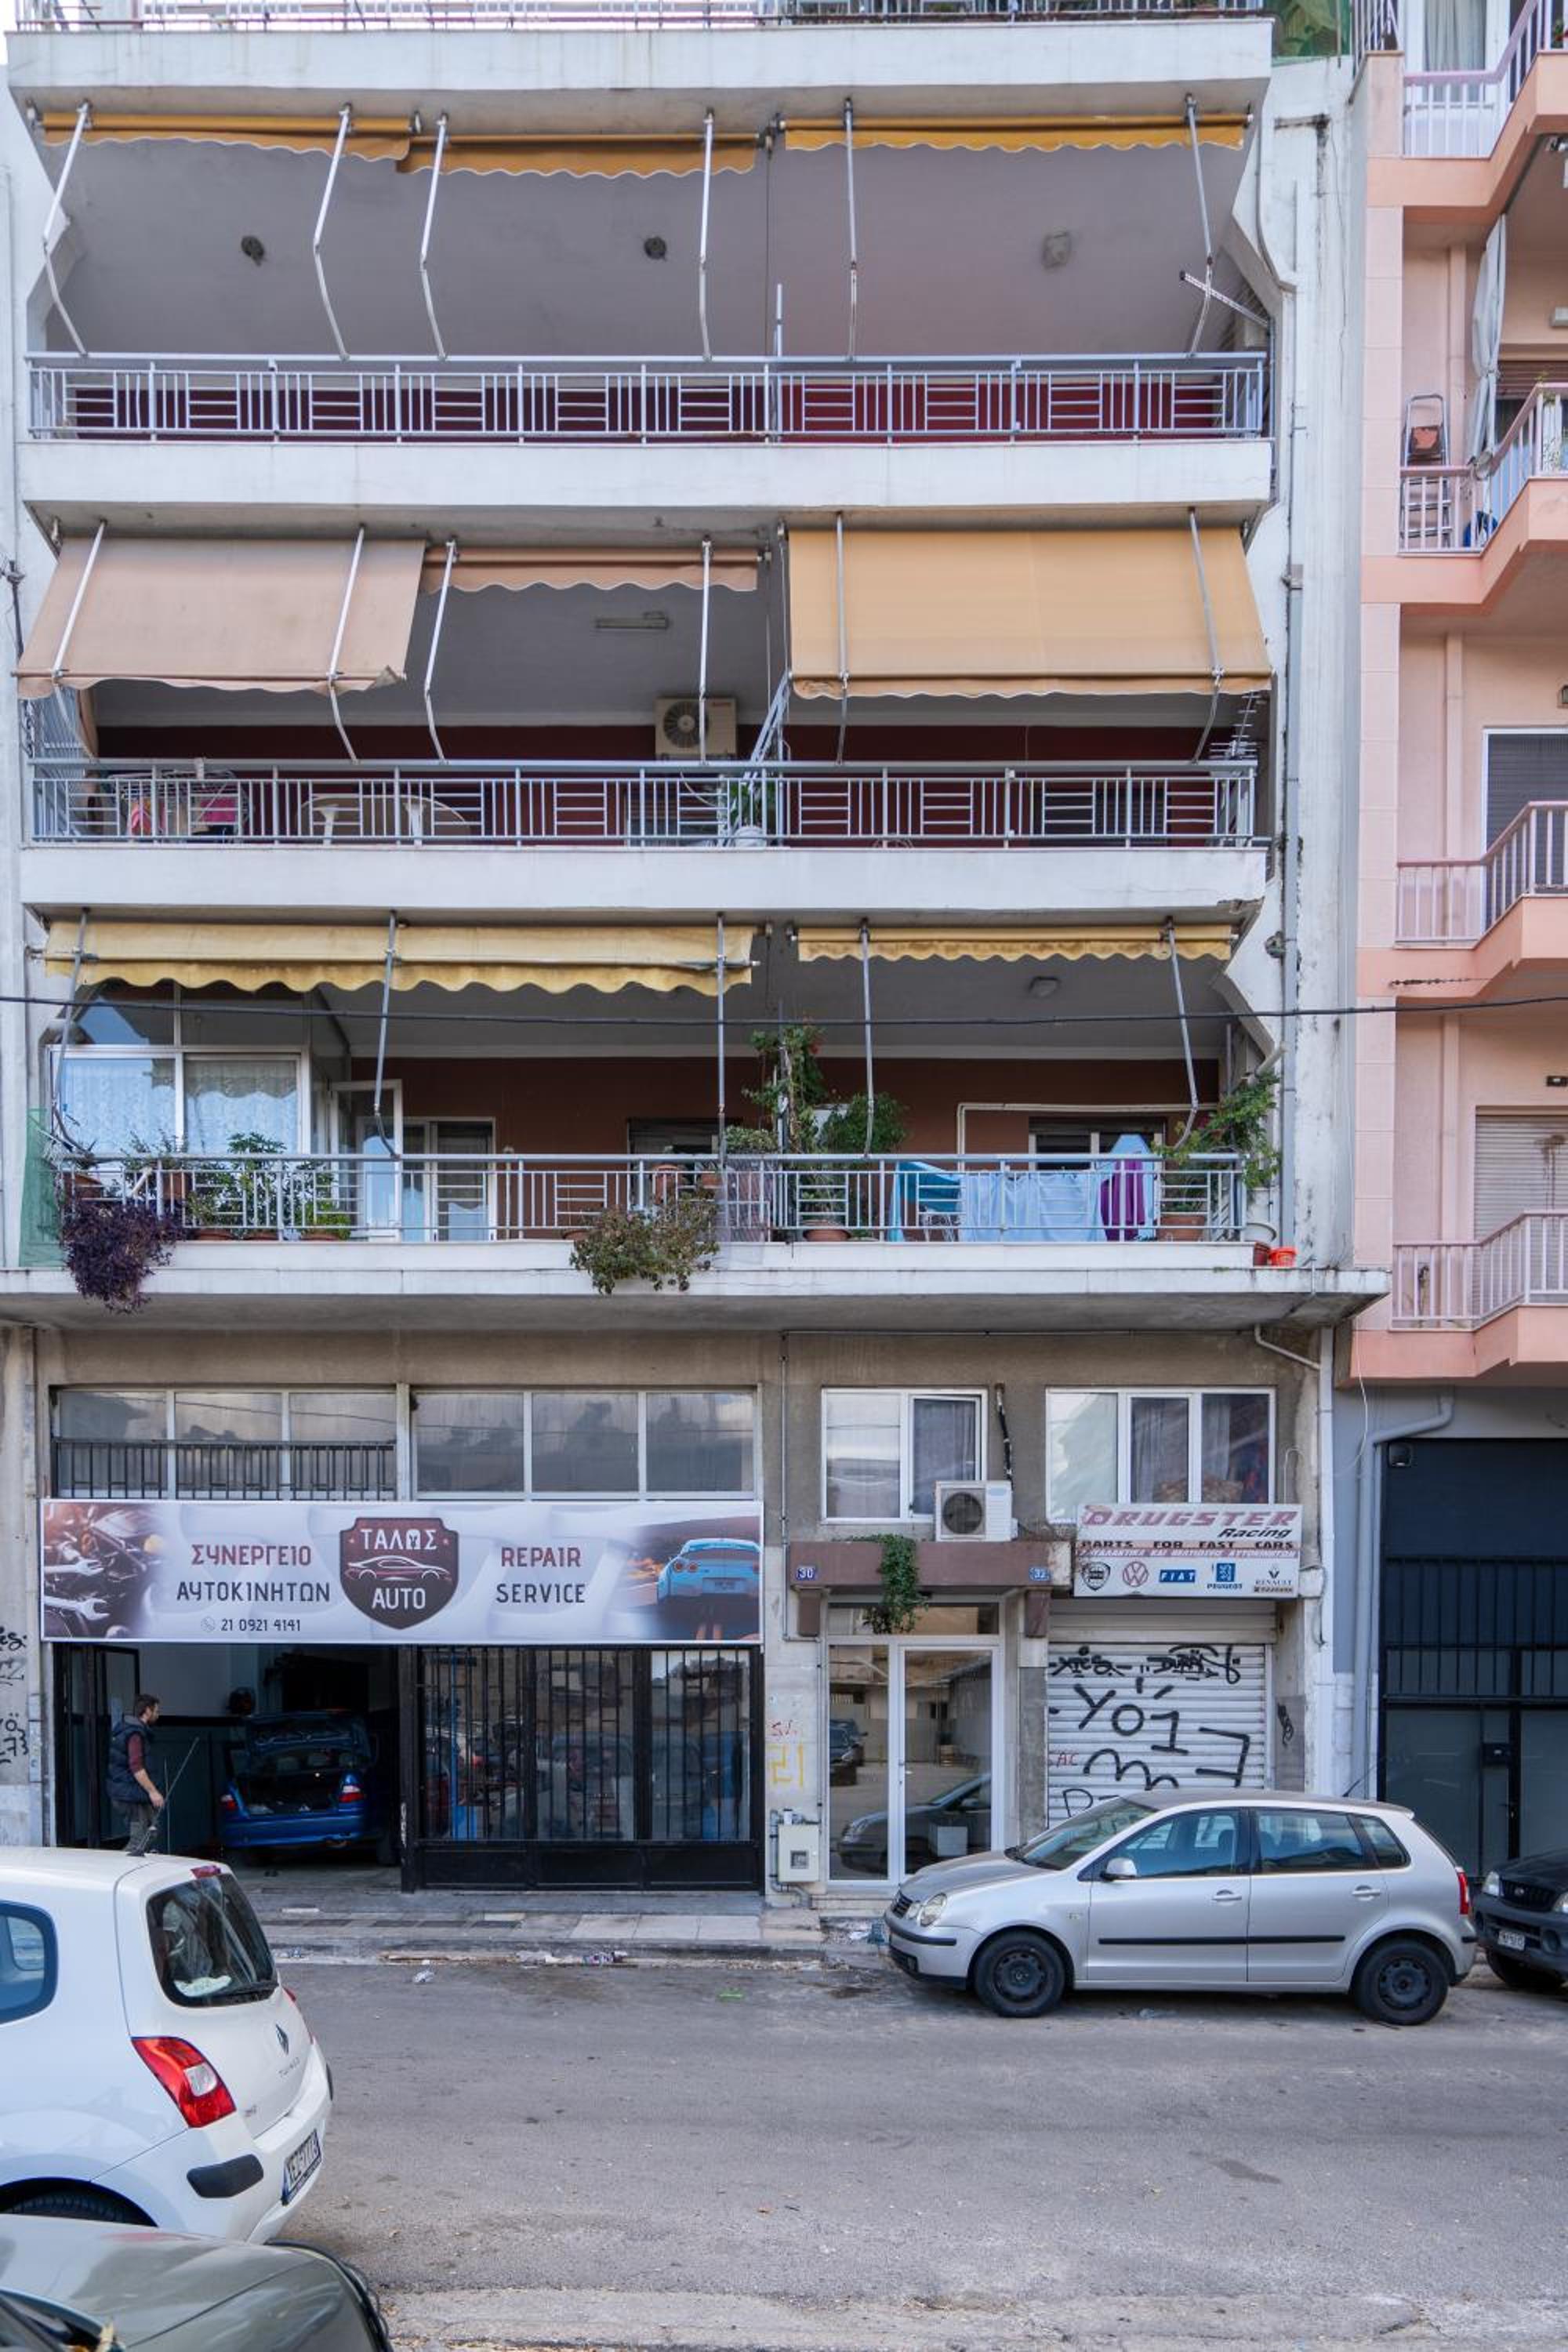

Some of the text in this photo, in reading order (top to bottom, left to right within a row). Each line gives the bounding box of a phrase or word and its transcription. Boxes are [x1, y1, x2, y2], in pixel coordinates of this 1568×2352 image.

[1082, 1508, 1298, 1526] DRUGSTER
[1218, 1527, 1292, 1539] Racing
[1200, 1541, 1235, 1549] FAST
[1255, 1541, 1294, 1550] CARS
[191, 1544, 312, 1566] ΣΥΝΕΡΓΕΙΟ
[500, 1547, 581, 1567] REPAIR
[798, 1568, 814, 1579] 30
[1033, 1568, 1047, 1579] 32
[1160, 1571, 1196, 1581] FIAT
[176, 1581, 330, 1602] ΑΥΤΟΚΙΝΗΤΩΝ
[372, 1587, 426, 1610] AUTO
[495, 1583, 586, 1603] SERVICE
[221, 1619, 301, 1632] 21 0921 4141
